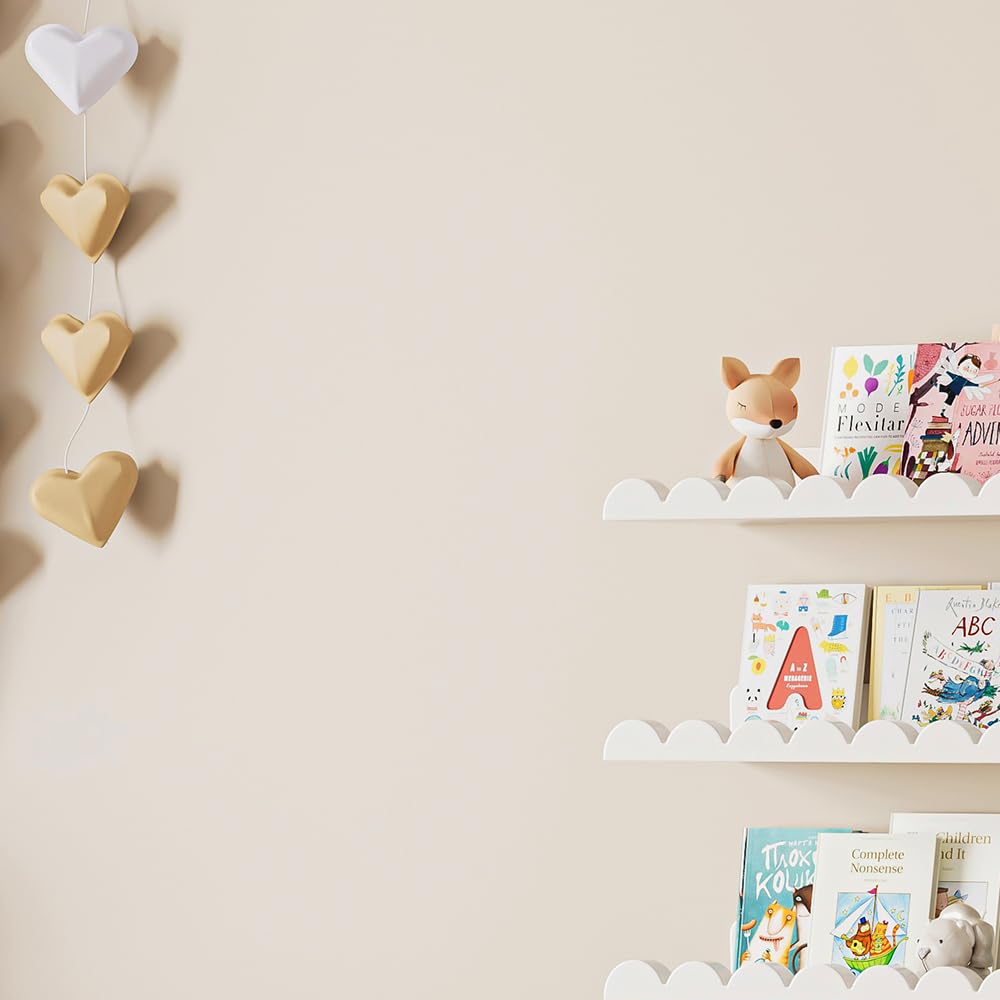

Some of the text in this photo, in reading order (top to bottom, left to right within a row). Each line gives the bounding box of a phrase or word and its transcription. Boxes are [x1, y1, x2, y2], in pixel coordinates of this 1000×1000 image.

[960, 404, 987, 417] SUGAR
[837, 414, 905, 432] Flexitar
[951, 615, 996, 638] ABC
[851, 848, 905, 862] Complete
[957, 848, 966, 860] It
[851, 862, 904, 874] Nonsense
